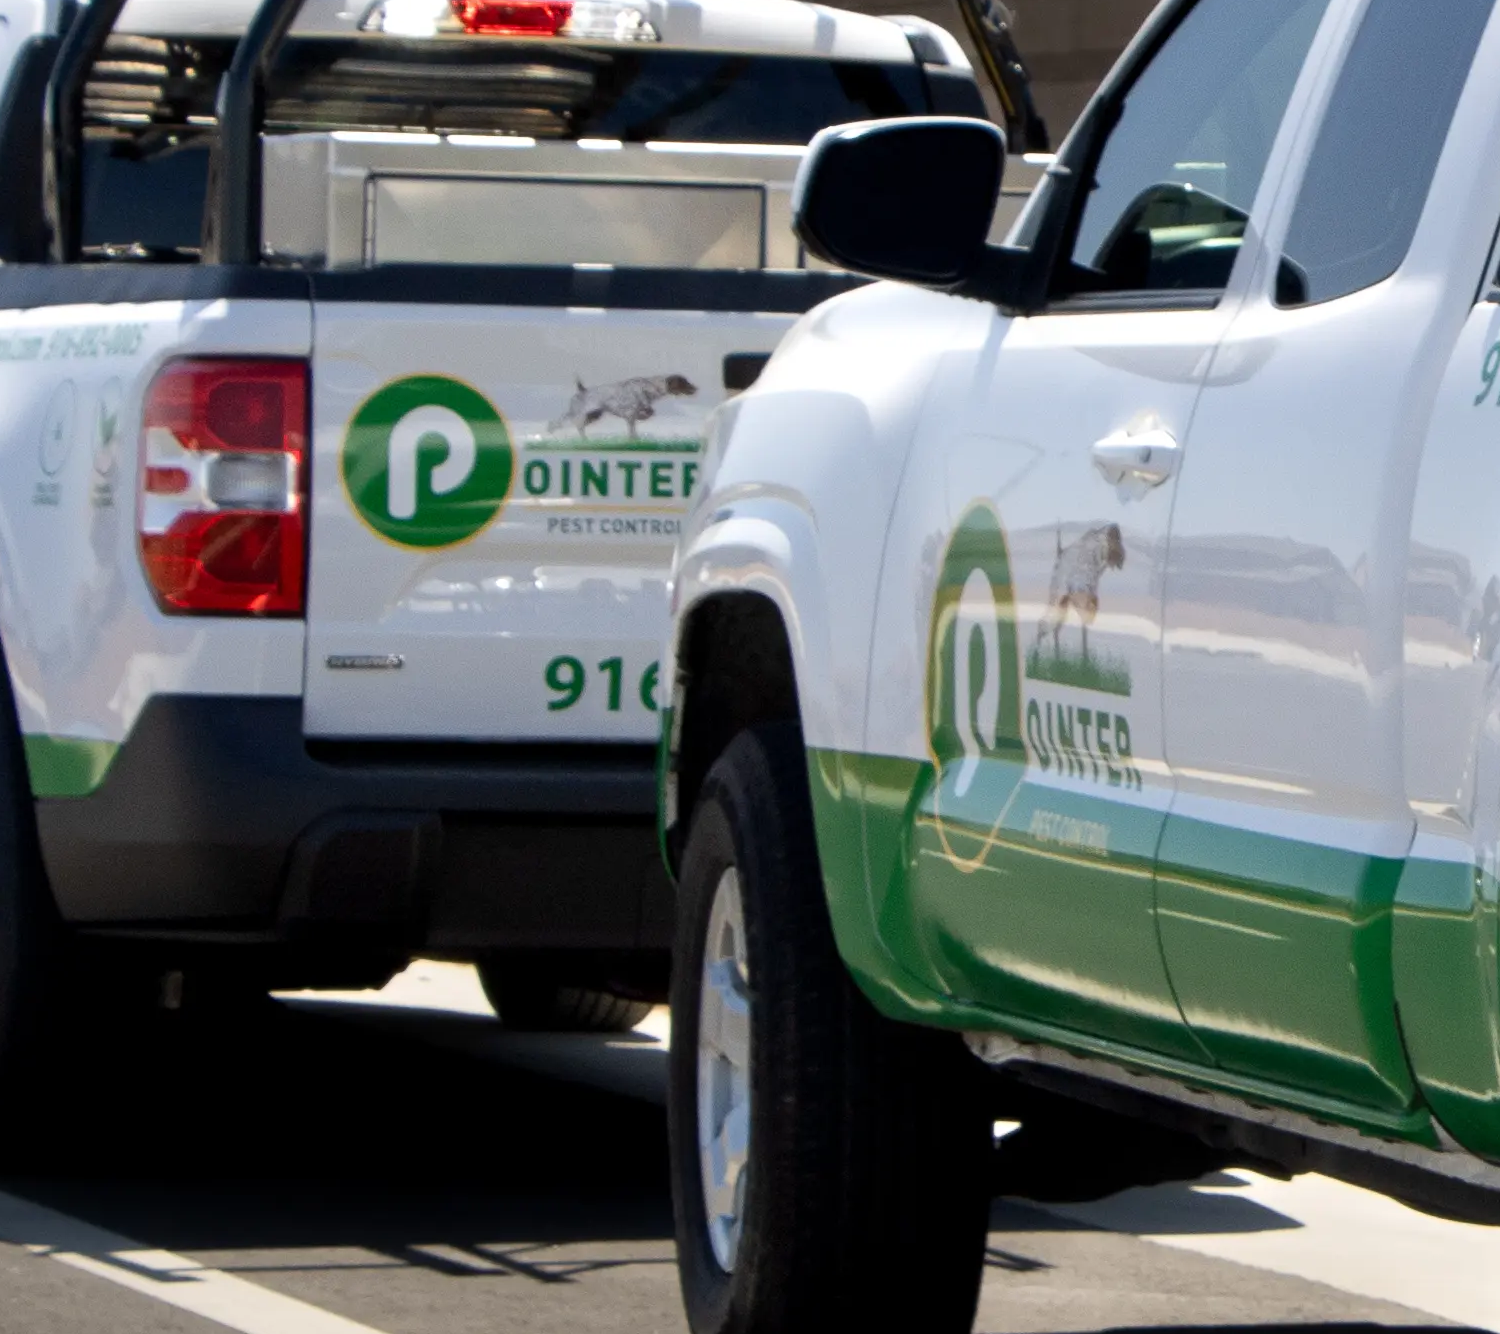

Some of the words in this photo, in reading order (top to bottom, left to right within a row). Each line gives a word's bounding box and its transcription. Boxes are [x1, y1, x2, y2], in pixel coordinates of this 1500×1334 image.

[388, 404, 477, 519] P
[549, 518, 594, 533] PEST
[1027, 698, 1143, 792] OINTER
